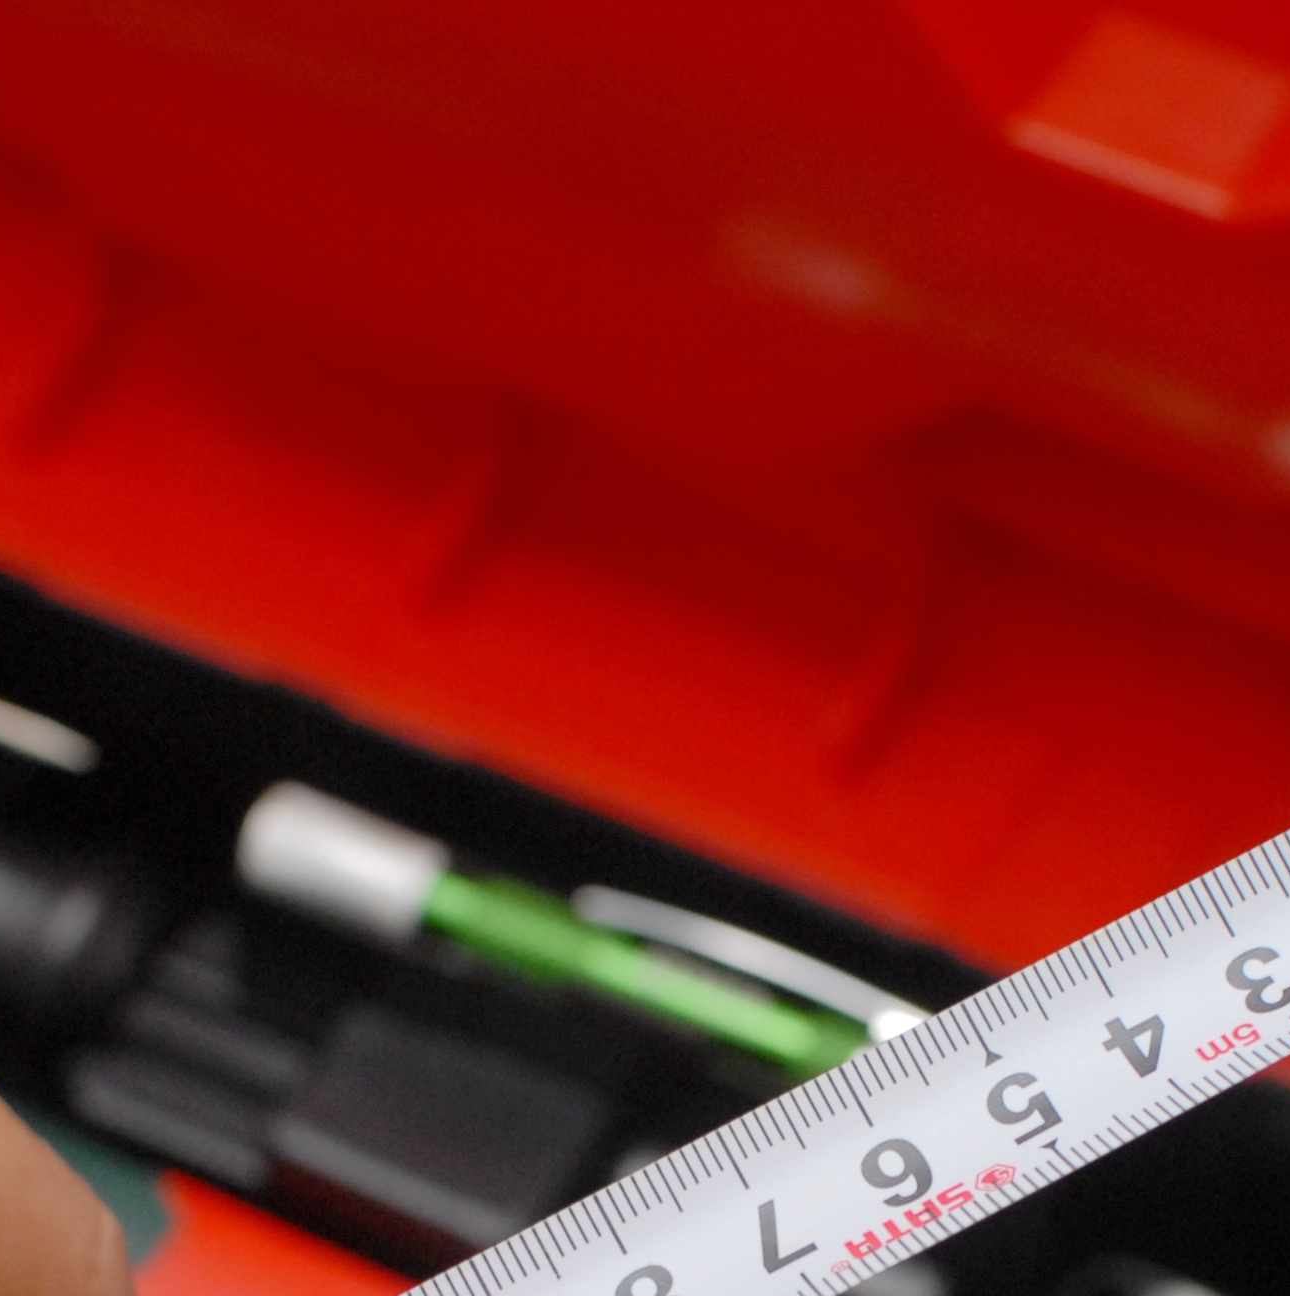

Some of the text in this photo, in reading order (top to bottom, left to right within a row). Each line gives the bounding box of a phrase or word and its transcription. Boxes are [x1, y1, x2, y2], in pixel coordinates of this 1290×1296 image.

[1101, 1013, 1166, 1078] 4
[1195, 1022, 1262, 1063] 5m
[986, 1071, 1063, 1147] 5
[860, 1138, 933, 1208] 6
[757, 1200, 818, 1273] 7
[843, 1182, 975, 1260] SATA
